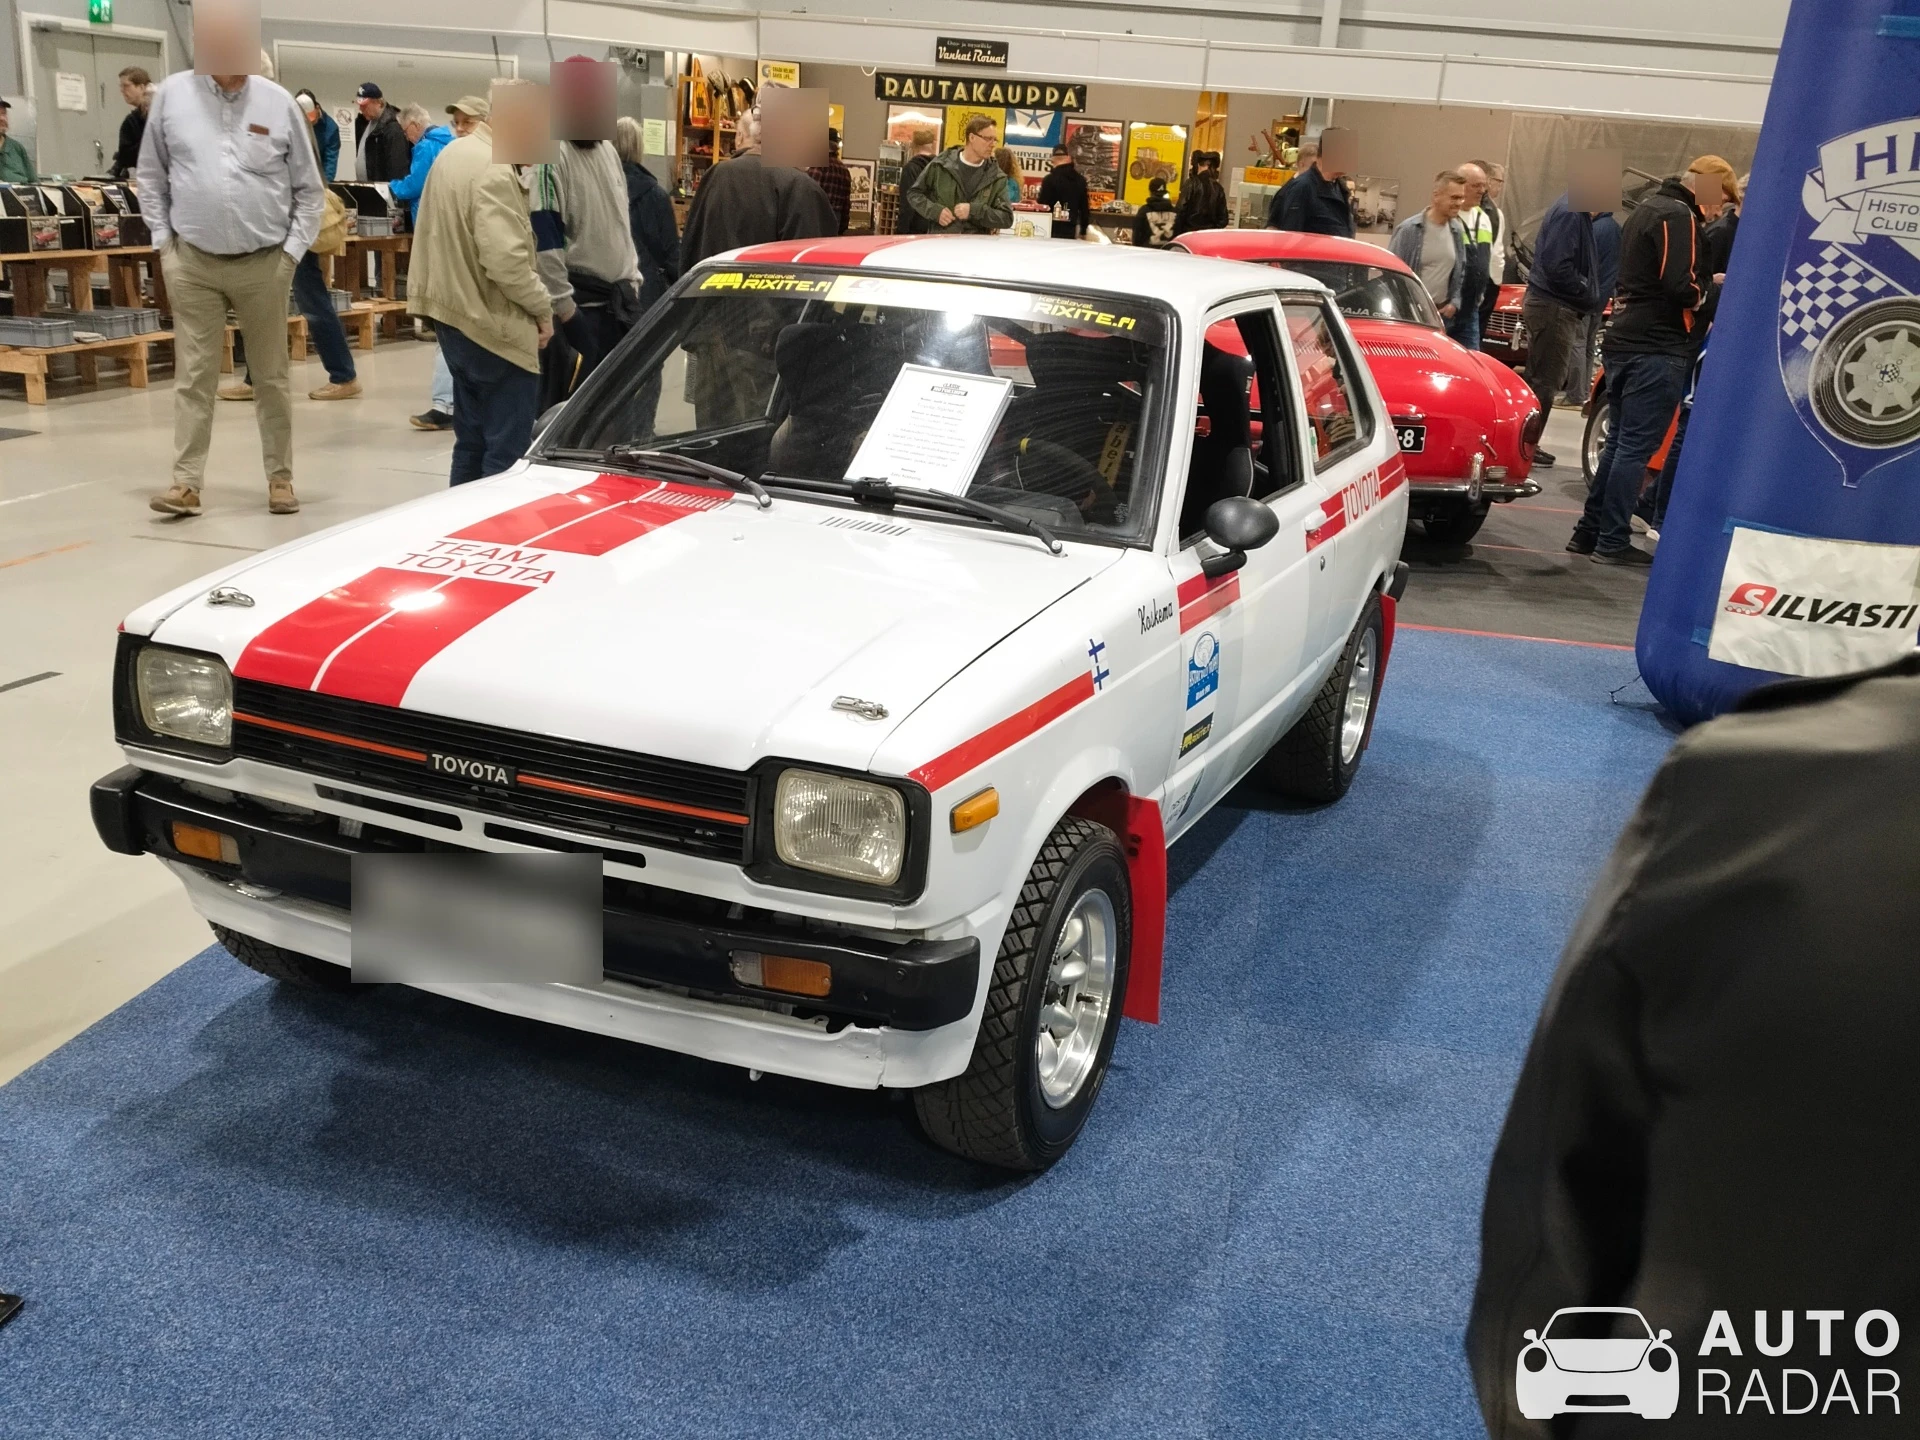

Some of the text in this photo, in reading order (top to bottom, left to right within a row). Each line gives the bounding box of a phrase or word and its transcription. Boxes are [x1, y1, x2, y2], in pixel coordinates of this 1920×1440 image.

[938, 46, 1006, 64] Vanhat Roinat
[884, 77, 1079, 108] RAUTAKAUPPA
[1013, 150, 1052, 158] HRYSLE
[1017, 157, 1053, 173] ARTS
[1867, 198, 1920, 216] HISTO
[1871, 216, 1918, 233] CLUB
[1038, 296, 1094, 310] Kertalavat
[1342, 469, 1381, 524] TOYOTA
[426, 540, 548, 564] TEAM
[397, 552, 556, 584] TOYOTA
[1138, 598, 1173, 635] Koskema
[1743, 588, 1919, 629] SILVASTI
[432, 753, 509, 785] TOYOTA
